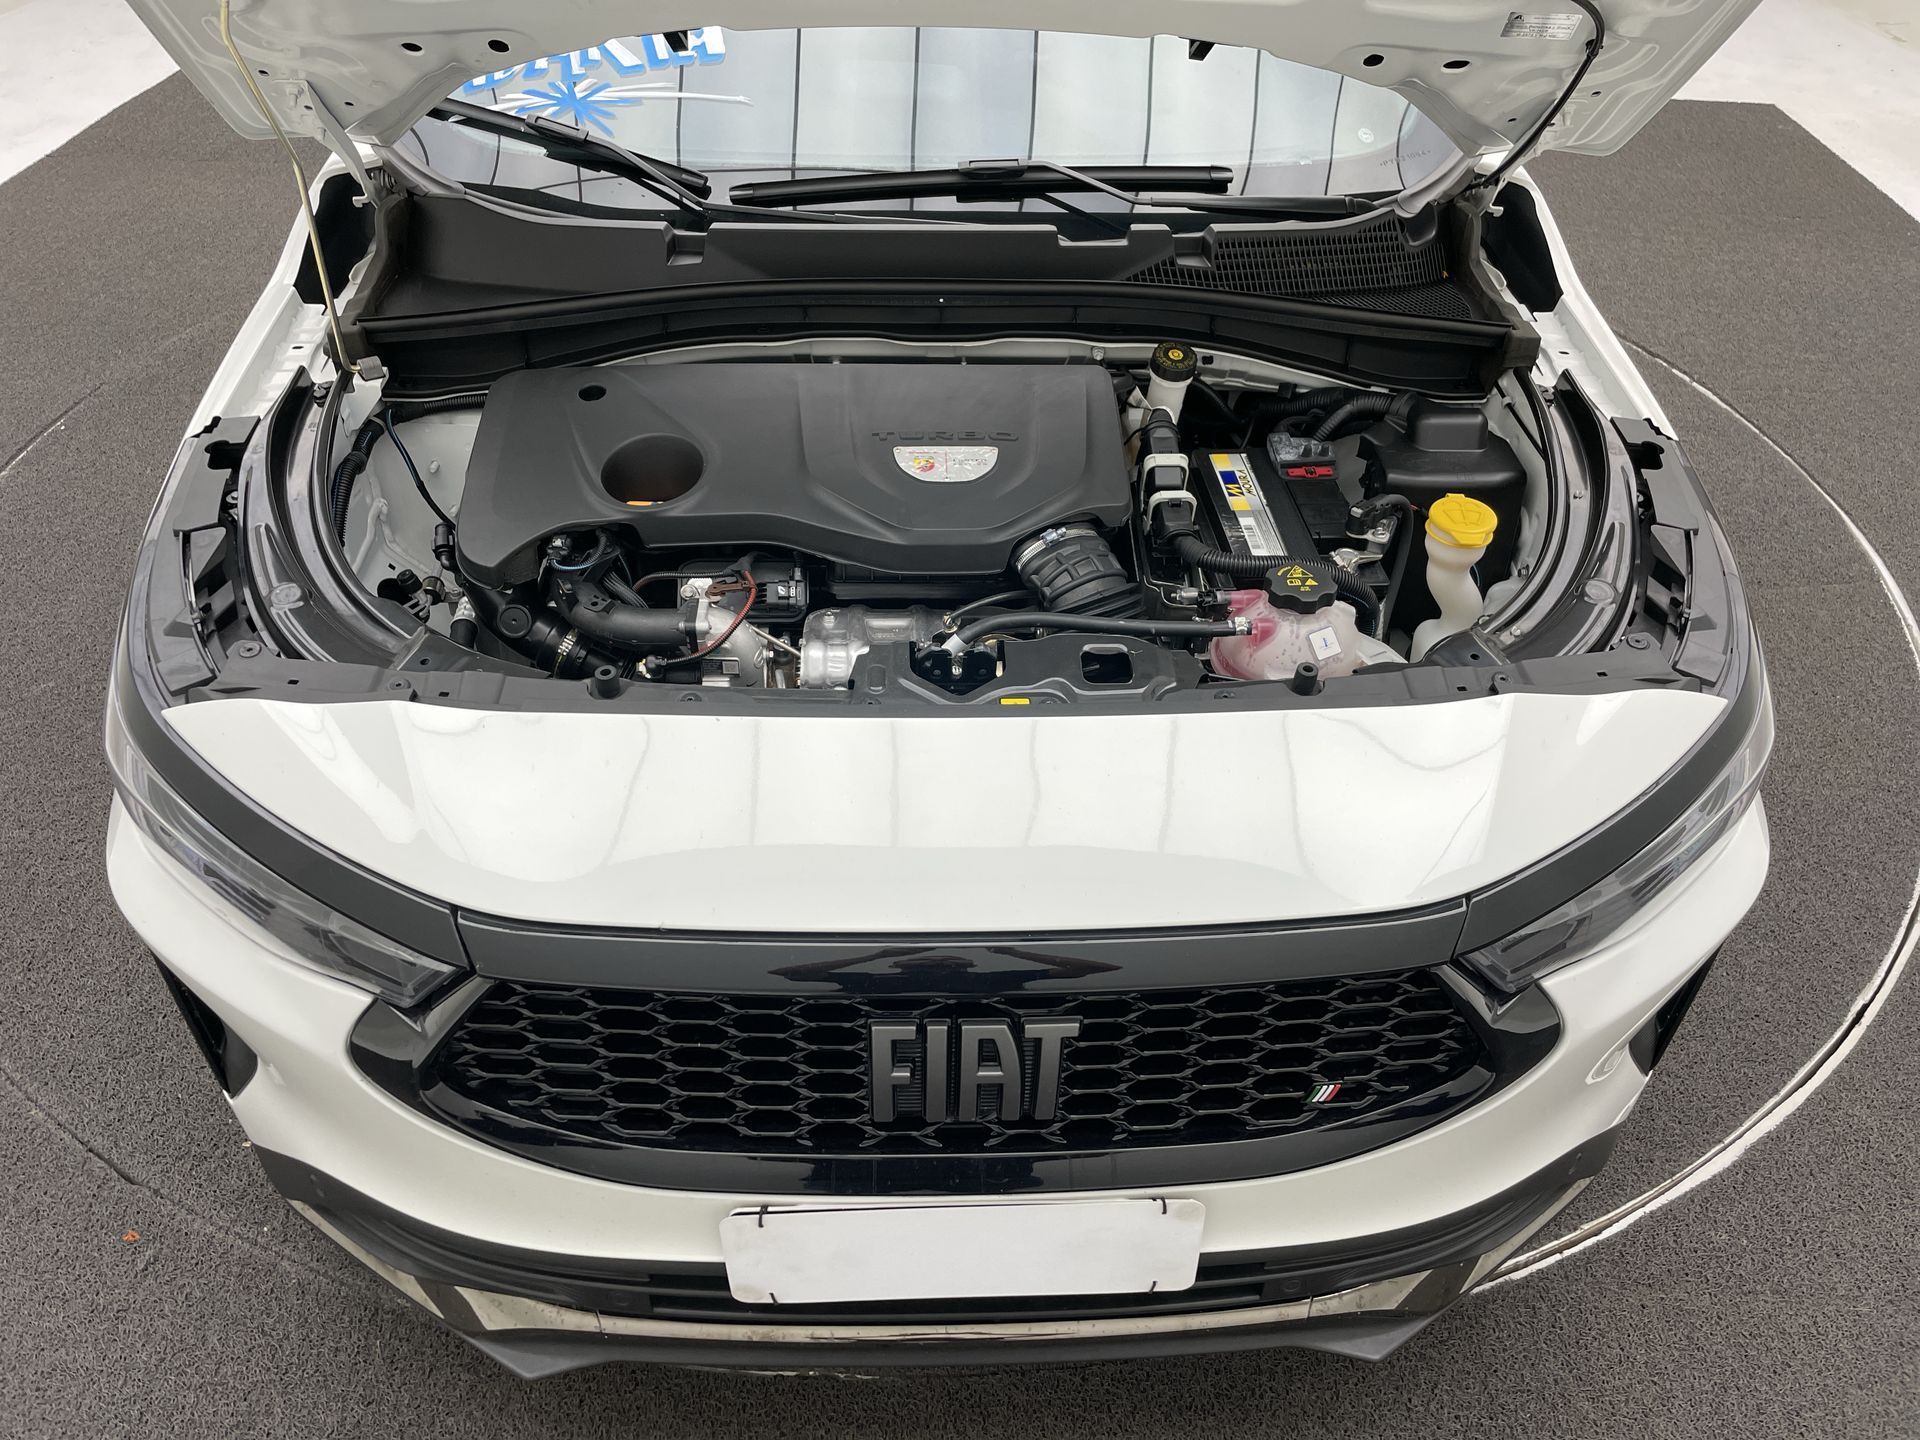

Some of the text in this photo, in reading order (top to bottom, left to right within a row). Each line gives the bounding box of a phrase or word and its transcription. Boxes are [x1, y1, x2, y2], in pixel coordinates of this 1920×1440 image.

[872, 431, 1019, 442] TURBO
[1236, 469, 1256, 497] MOURA
[868, 1018, 1083, 1122] FIAT
